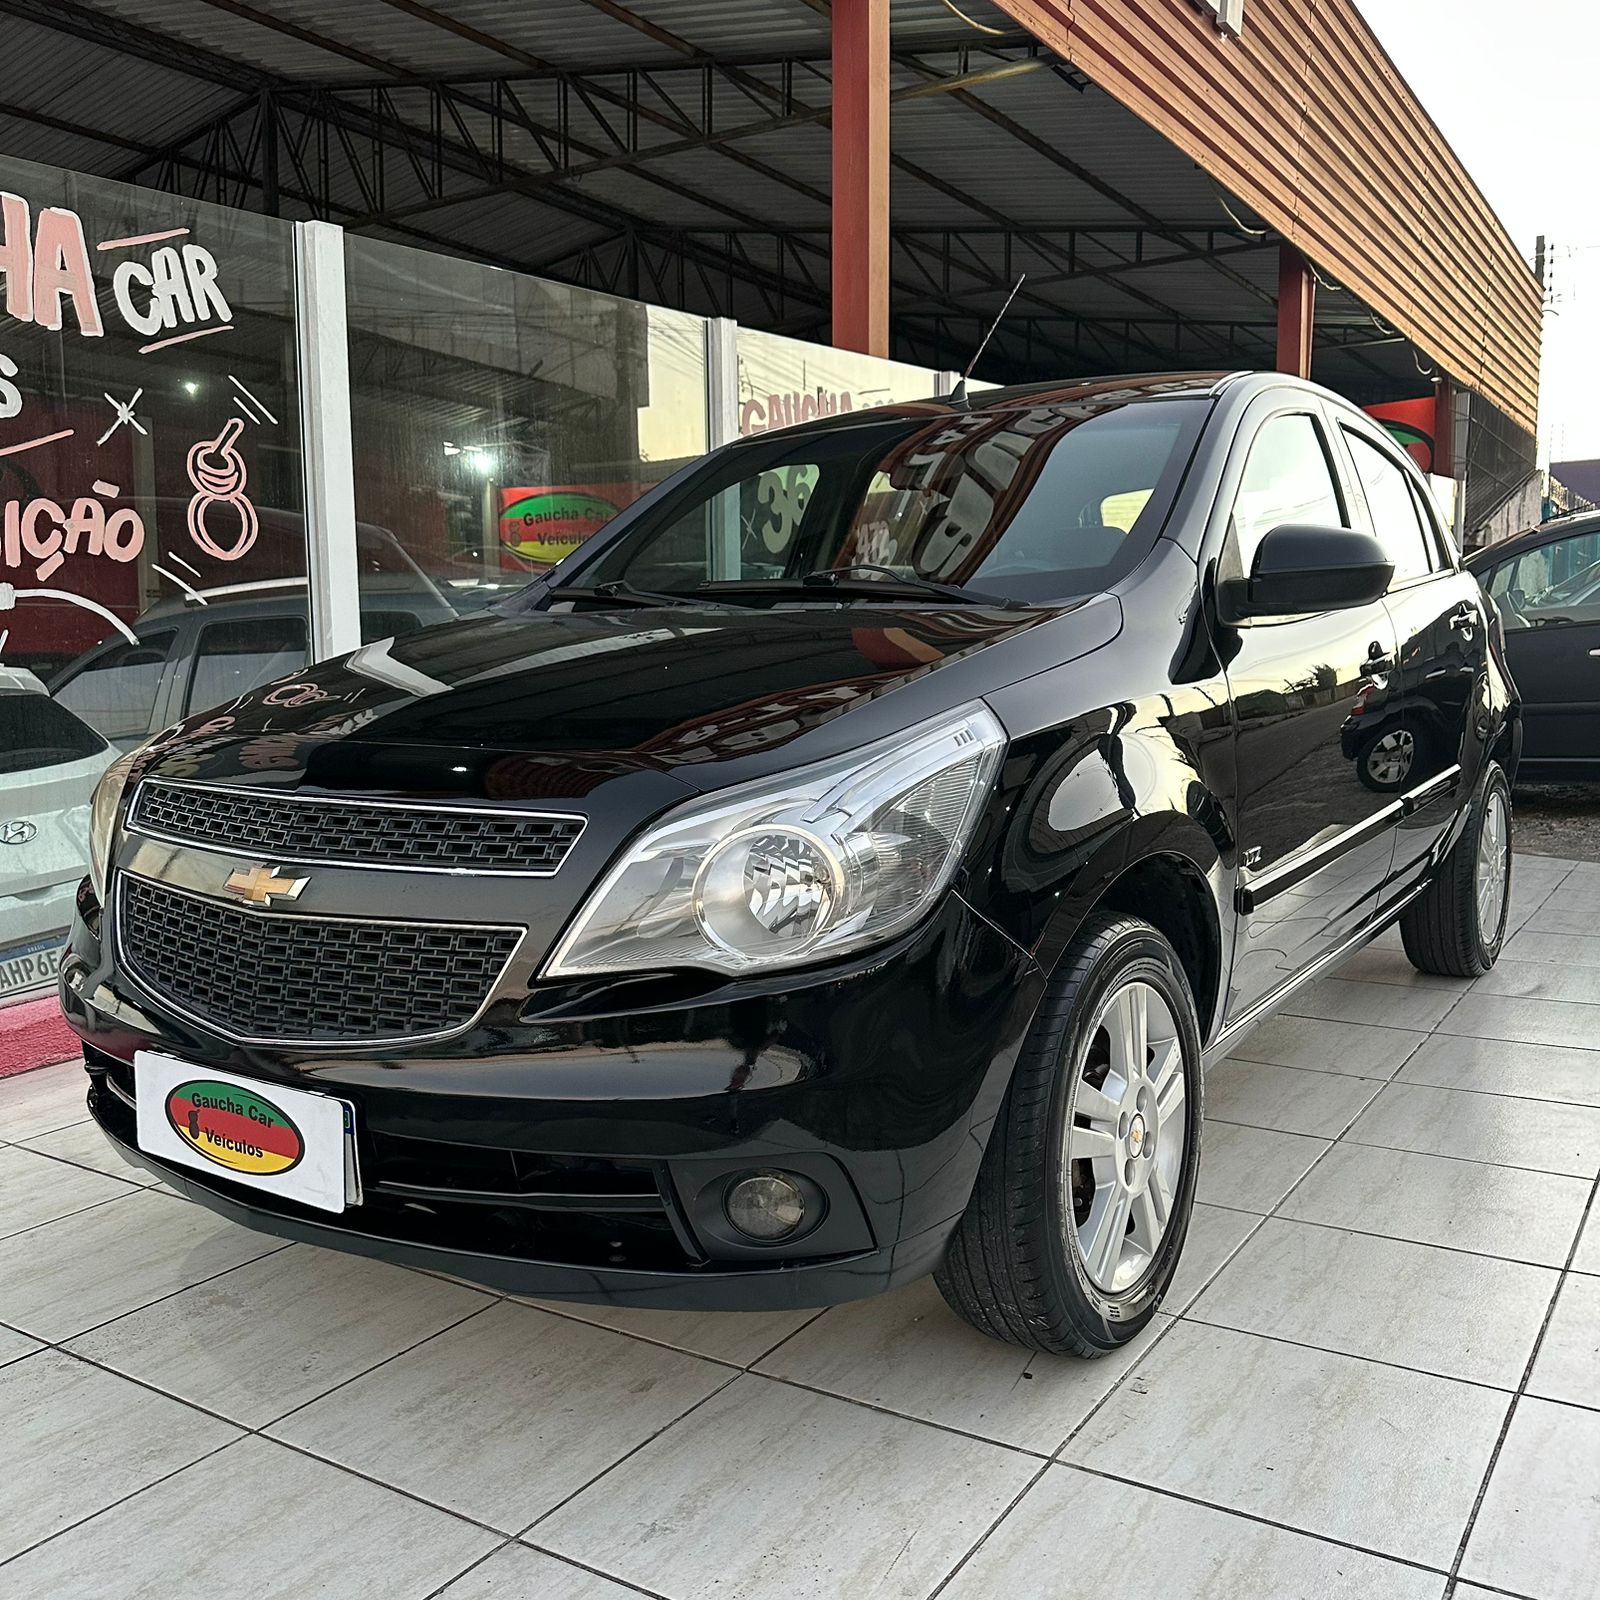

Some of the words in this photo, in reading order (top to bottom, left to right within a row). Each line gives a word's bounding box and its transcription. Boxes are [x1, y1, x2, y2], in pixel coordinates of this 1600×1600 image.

[112, 243, 233, 336] CAR
[523, 507, 579, 526] Gaucha
[0, 950, 58, 988] AHP6E
[192, 1092, 244, 1116] Gaucha
[248, 1105, 274, 1128] Car
